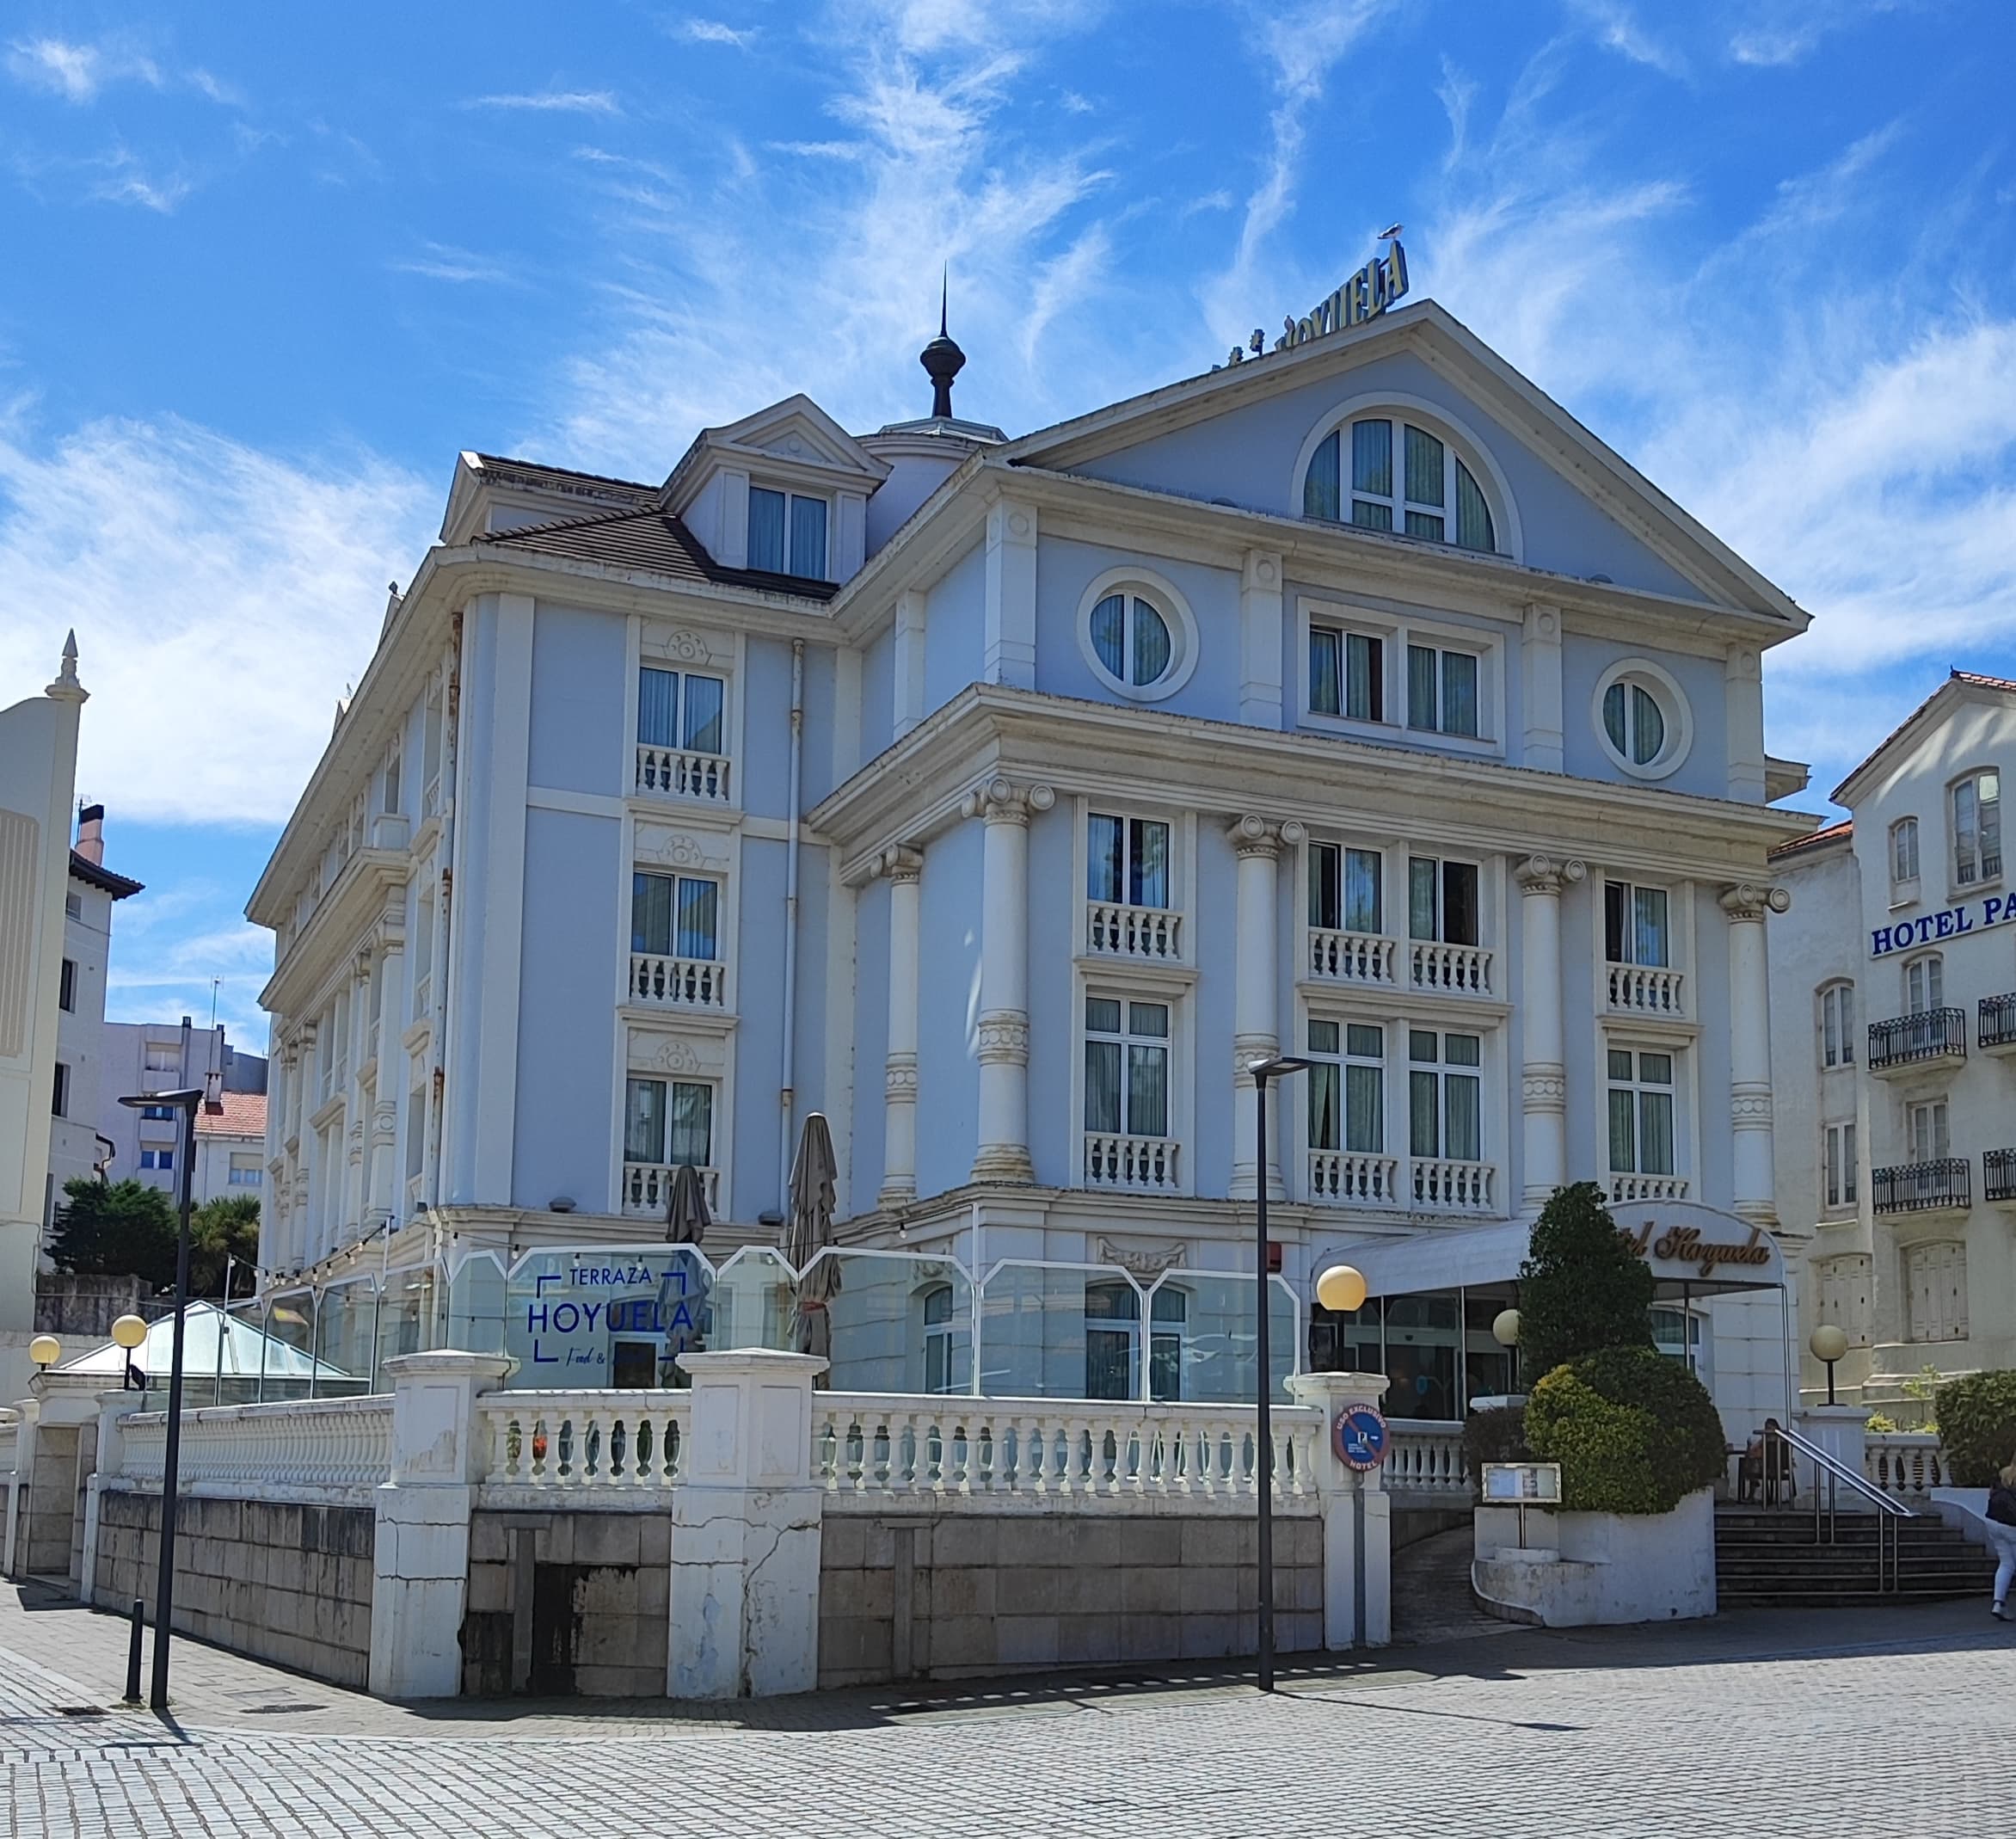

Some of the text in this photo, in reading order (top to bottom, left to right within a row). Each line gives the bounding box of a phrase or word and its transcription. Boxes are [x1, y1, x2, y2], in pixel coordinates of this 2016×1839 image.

[1872, 907, 1973, 955] HOTEL
[1653, 1226, 1770, 1277] Hoyuela
[569, 1267, 652, 1286] TERRAZA
[528, 1301, 693, 1333] HOYUELA
[1337, 1405, 1386, 1430] USO EXCLUSIVO
[1349, 1460, 1377, 1470] HOTEL
